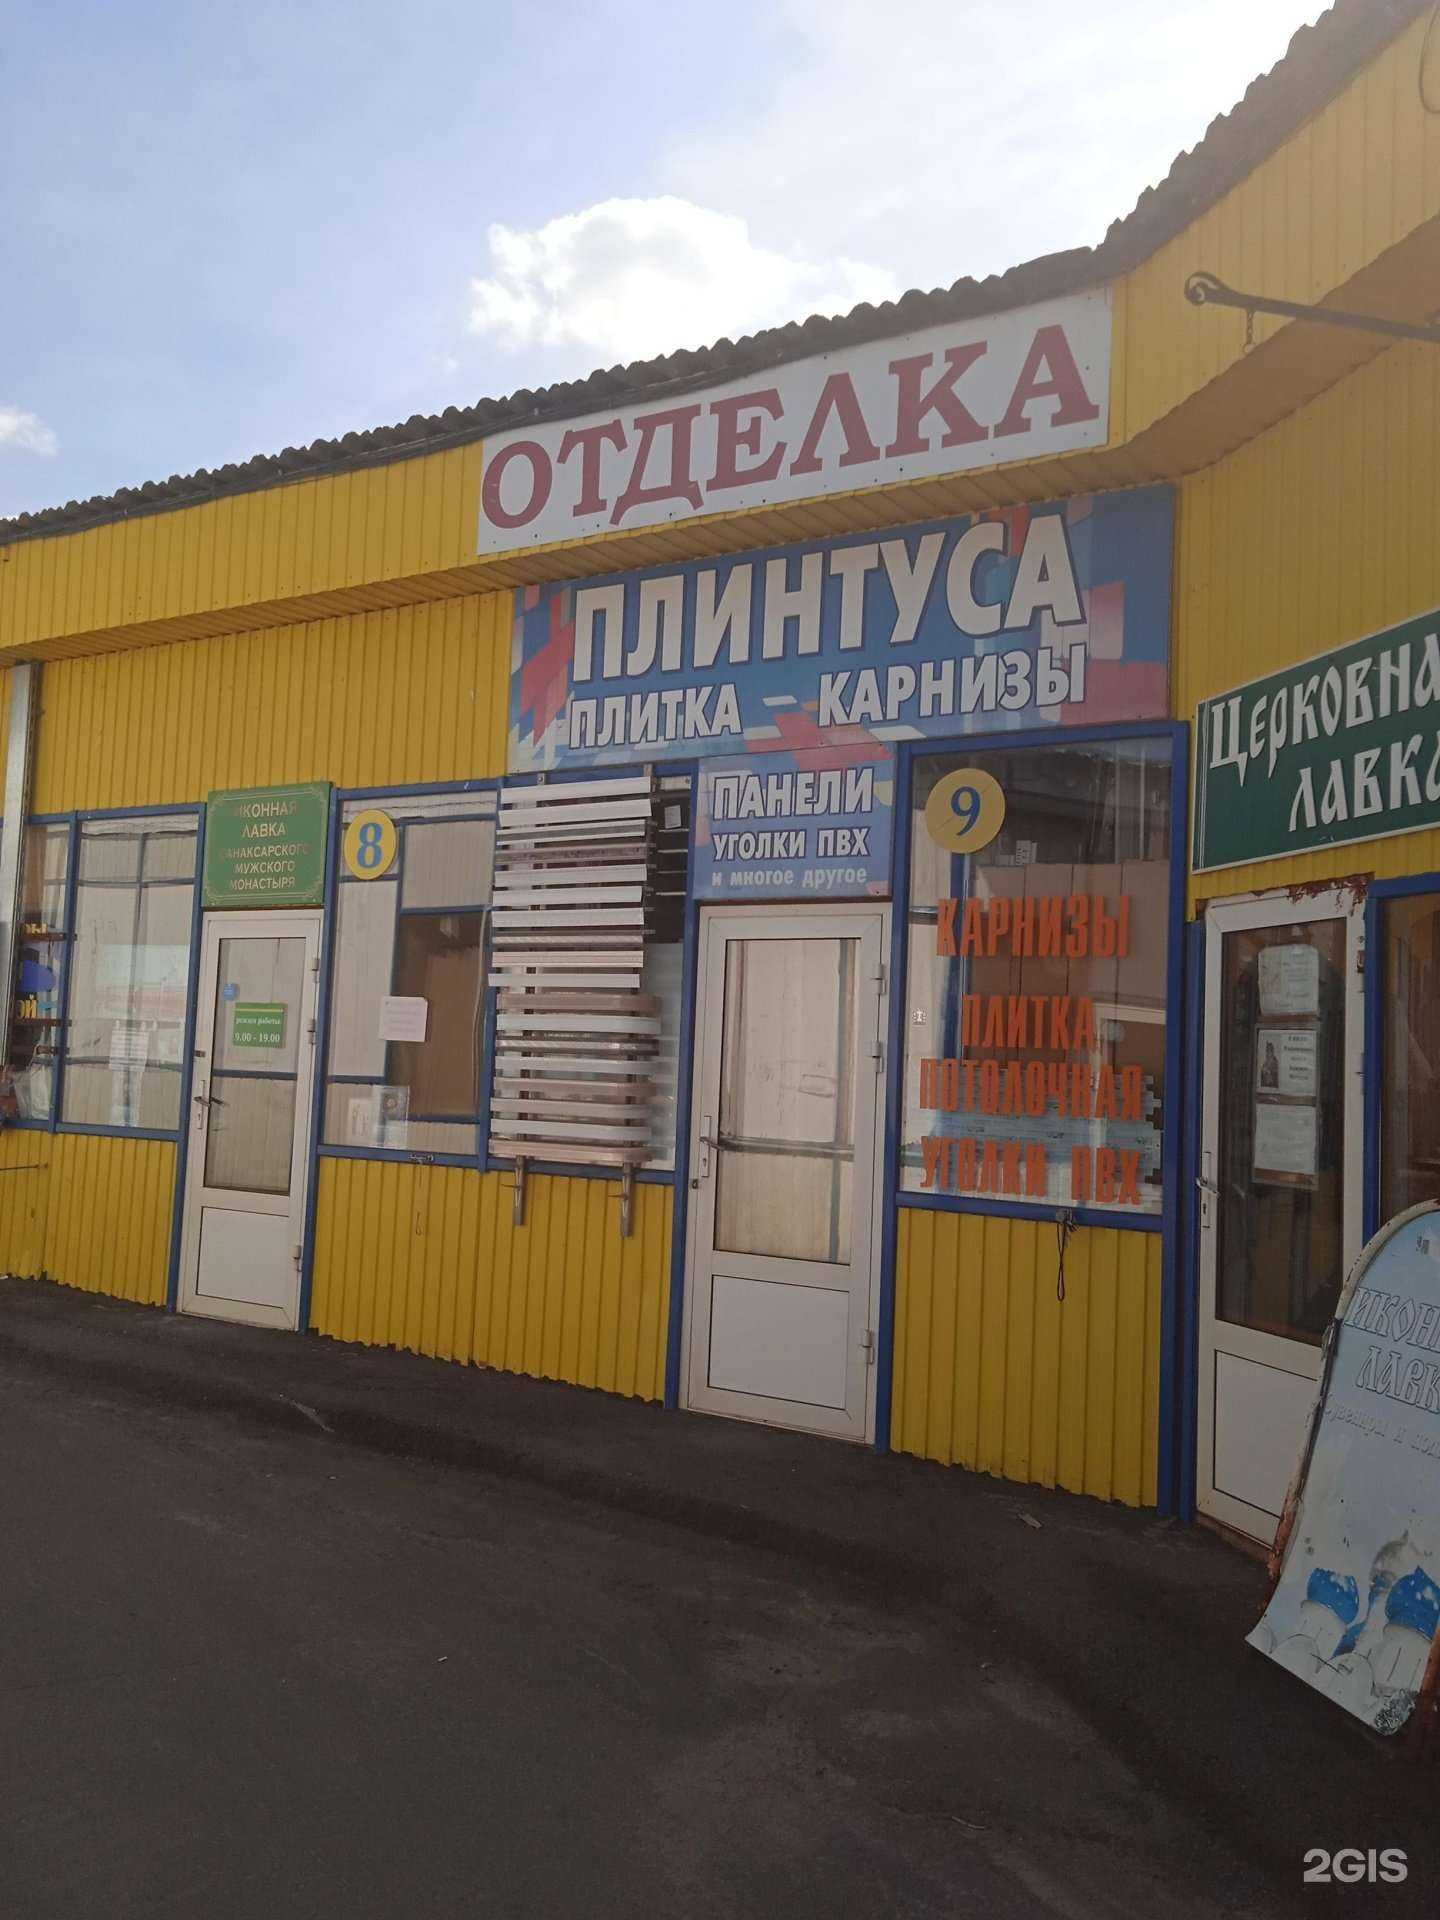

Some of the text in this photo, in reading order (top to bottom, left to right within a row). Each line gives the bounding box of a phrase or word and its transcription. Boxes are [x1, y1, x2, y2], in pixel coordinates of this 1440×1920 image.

[481, 324, 1099, 529] ОТДЕЛКА
[570, 514, 1087, 684] ПЛИНТУСА
[568, 643, 1088, 750] ПЛИТКА КАРНИЗЫ
[713, 767, 875, 821] ПАНЕЛИ
[950, 786, 981, 836] 9
[241, 822, 287, 838] ЛАВКА
[357, 822, 384, 868] 8
[711, 826, 871, 862] УГОЛКИ ПВХ
[234, 861, 296, 874] МУЖСКОГО
[712, 867, 868, 890] и многое другое
[937, 892, 1131, 958] КАРНИЗЫ
[234, 1032, 252, 1042] 9.00
[259, 1032, 281, 1042] 19.00
[961, 994, 1096, 1050] ПЛИТКА
[919, 1058, 1143, 1121] ПОТОЛОЧНАЯ
[919, 1136, 1142, 1205] УГОЛКИ ПВХ
